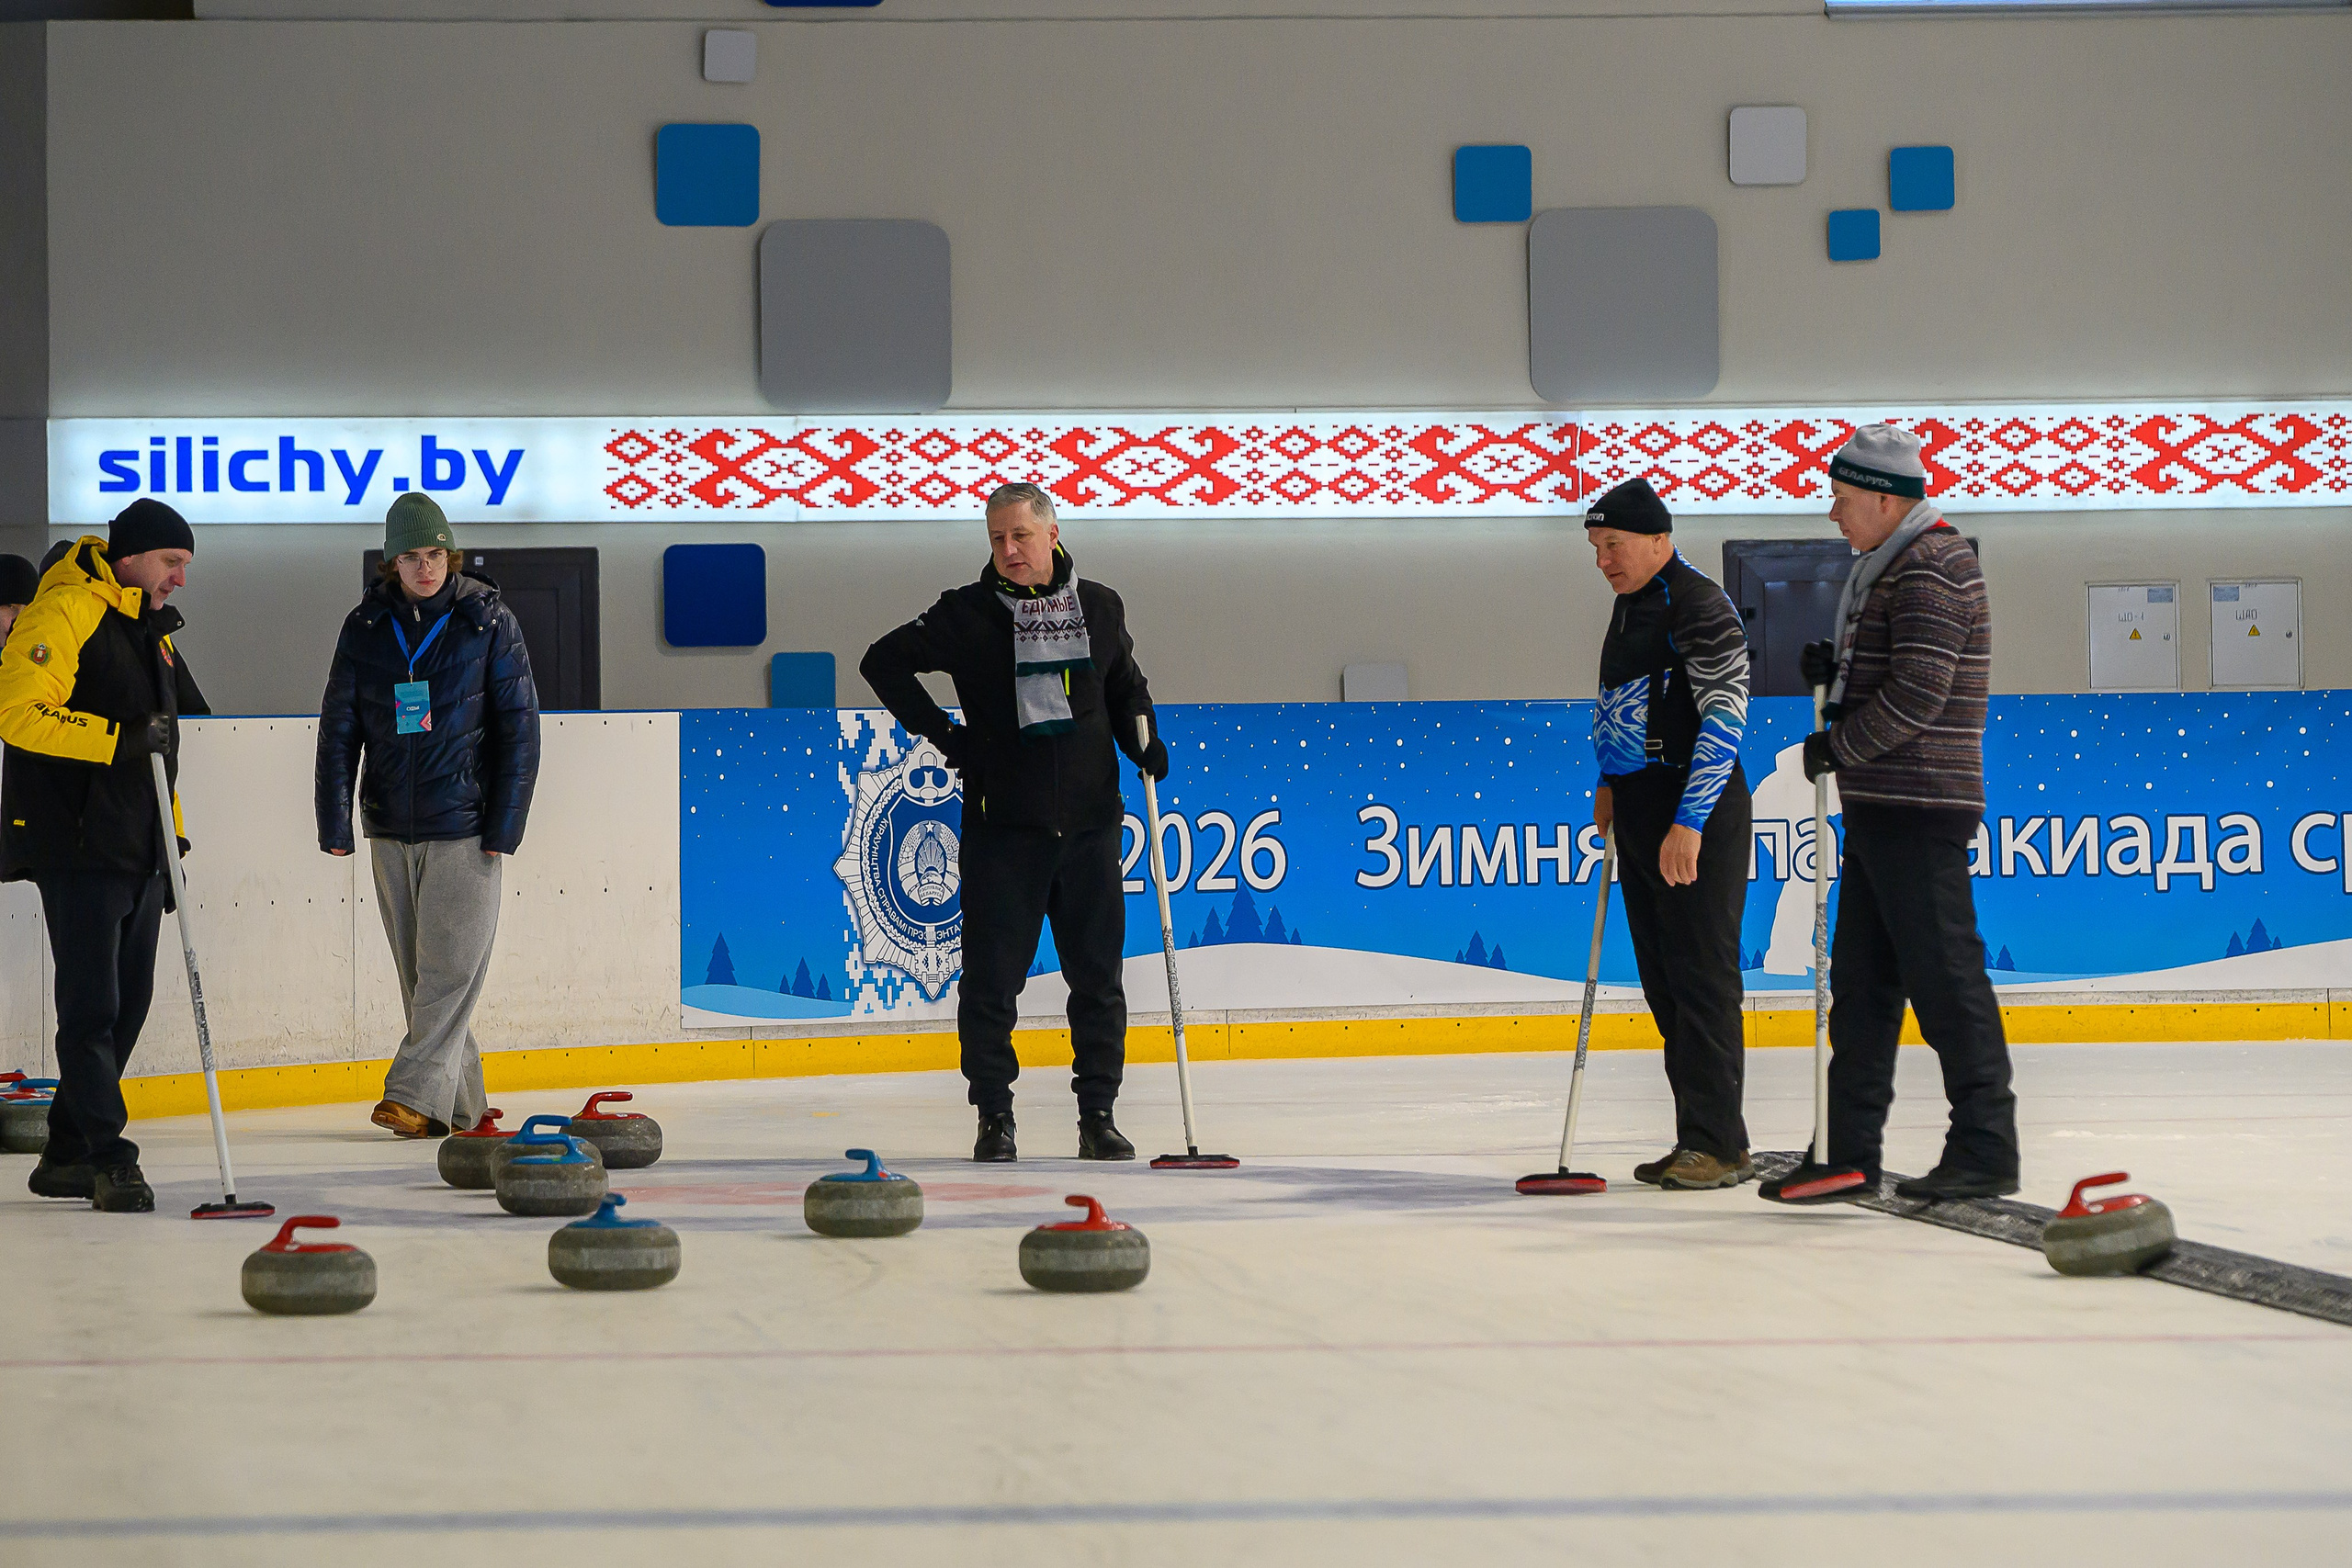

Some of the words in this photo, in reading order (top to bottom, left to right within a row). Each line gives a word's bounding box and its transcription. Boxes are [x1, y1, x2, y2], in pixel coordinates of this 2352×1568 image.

[98, 434, 525, 504] silichy.by
[1838, 467, 1893, 488] БЕЛАРУСЬ
[34, 703, 88, 728] BEAUS
[1121, 811, 1287, 893] 2026
[1357, 806, 1619, 887] Зимня
[1747, 813, 2264, 891] паакиада
[2290, 812, 2352, 893] с
[908, 924, 961, 940] ПРЭЭНТА
